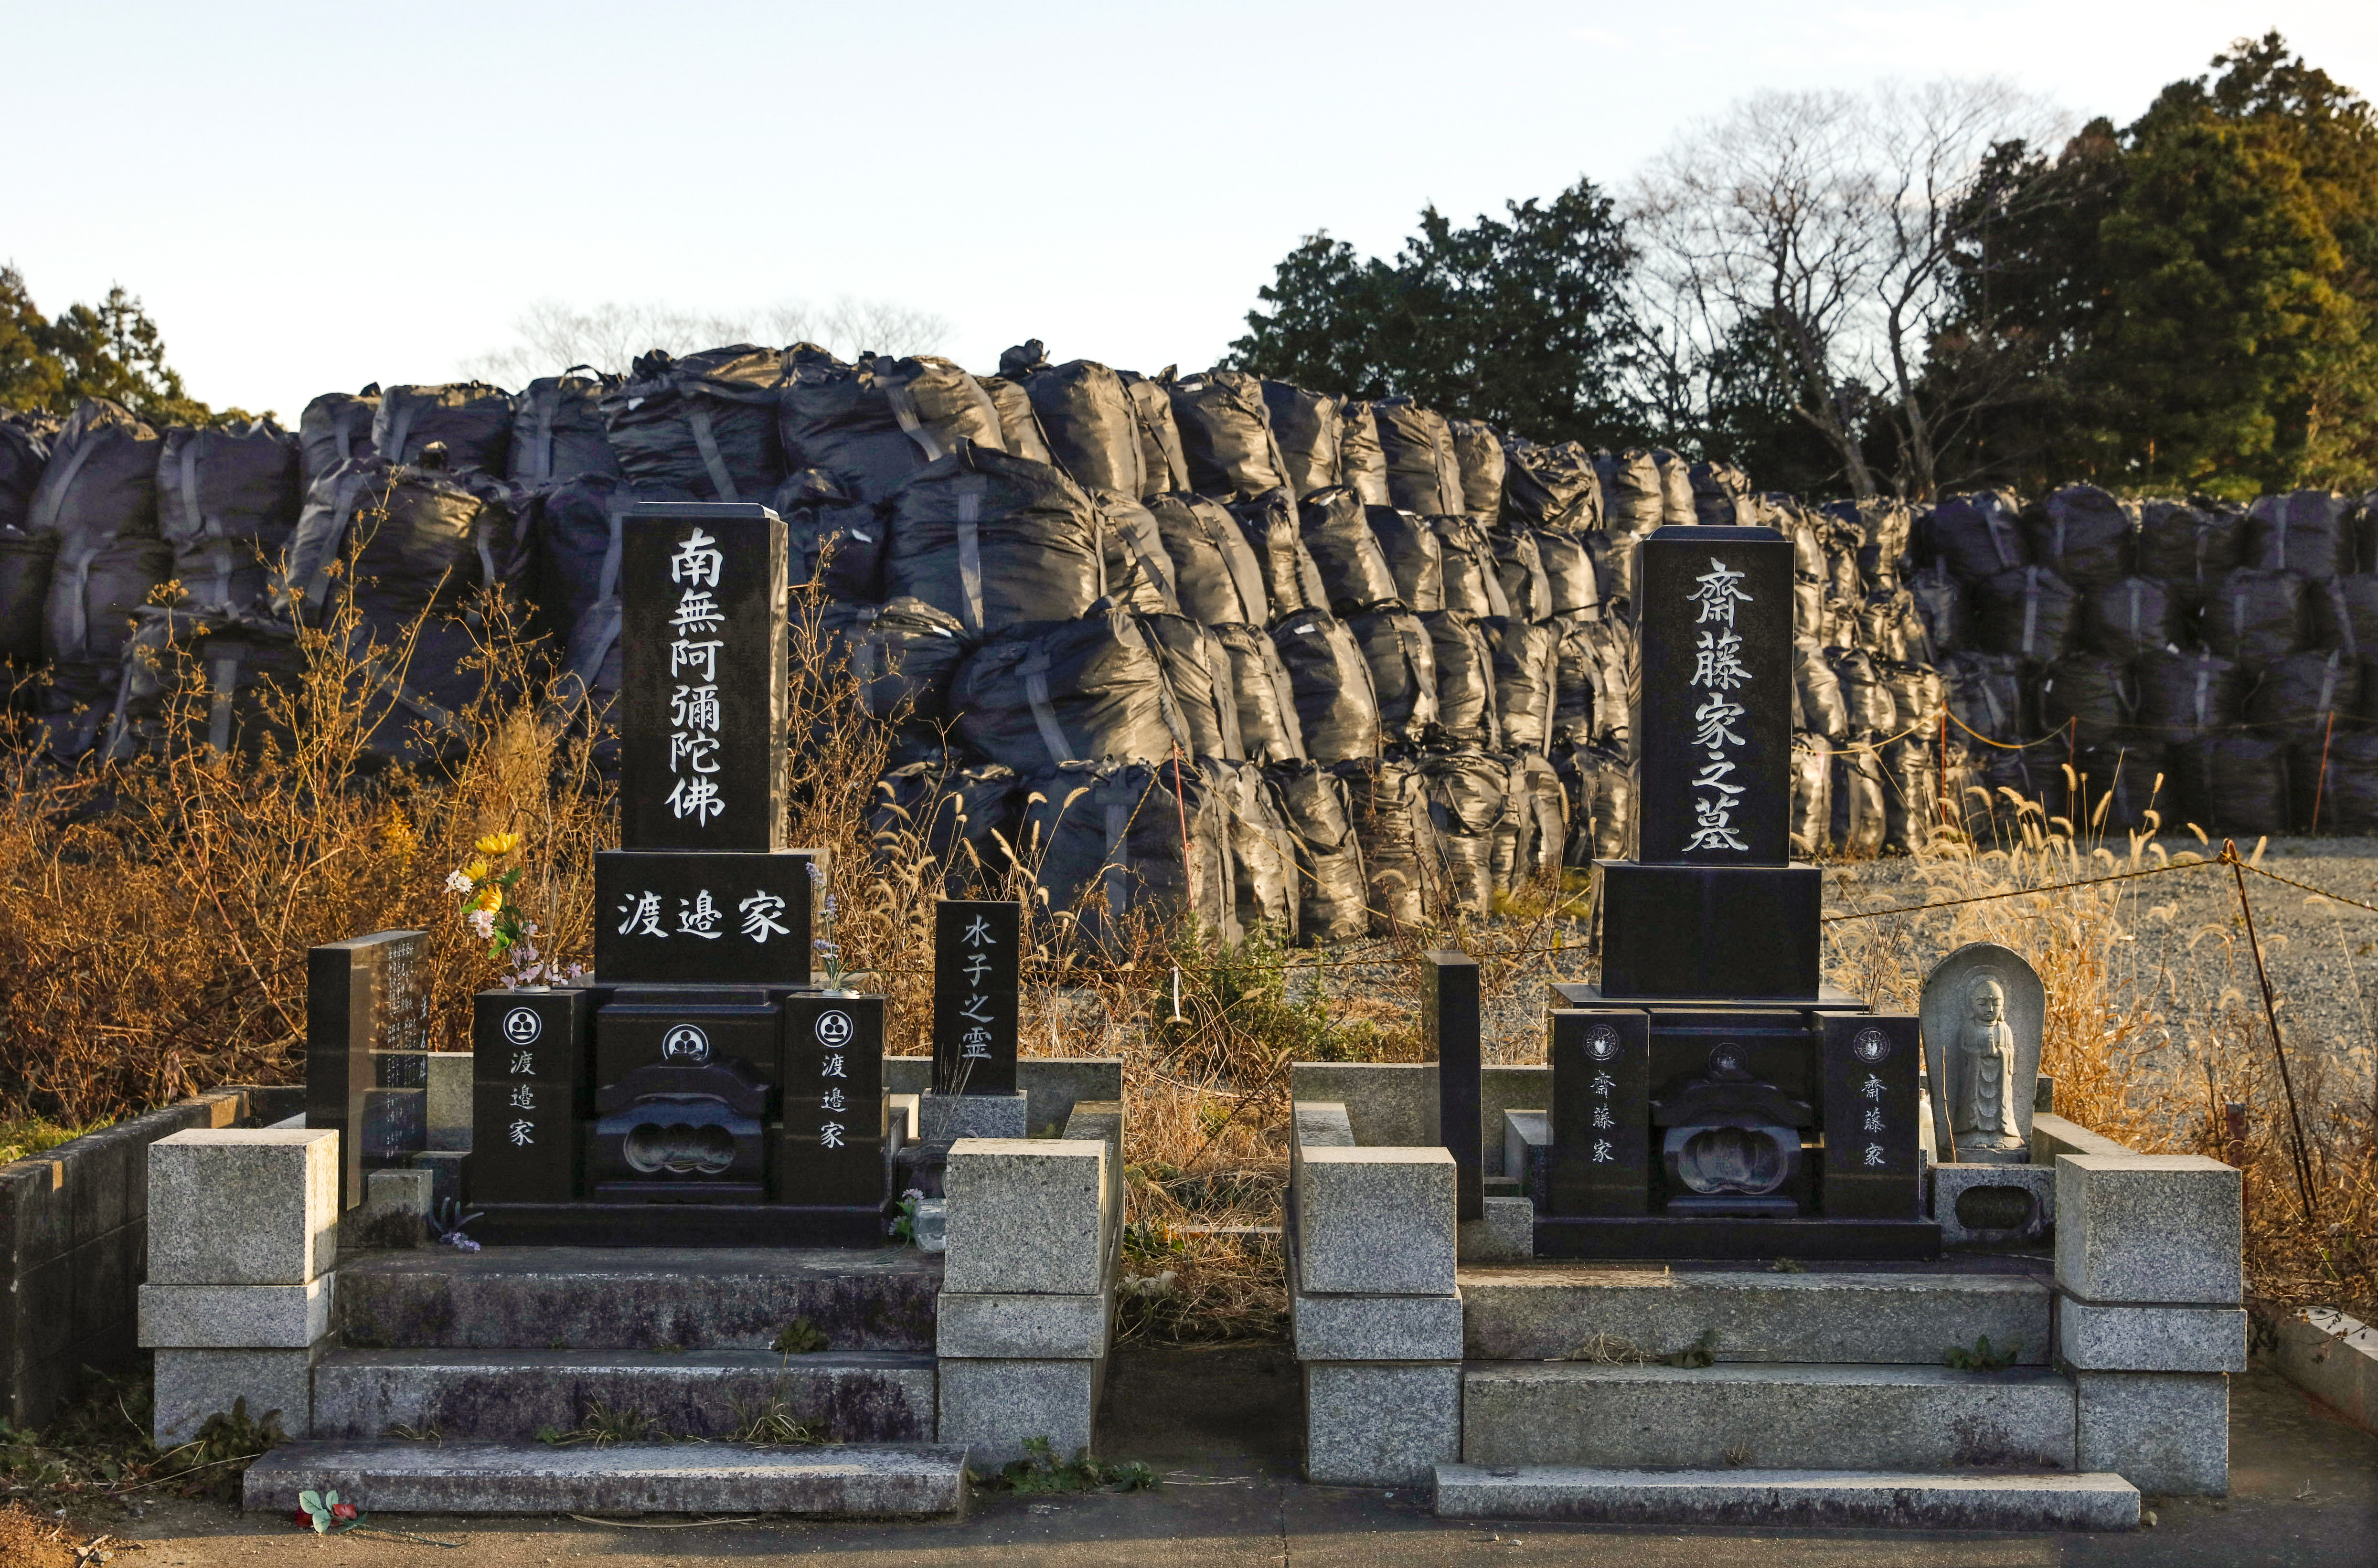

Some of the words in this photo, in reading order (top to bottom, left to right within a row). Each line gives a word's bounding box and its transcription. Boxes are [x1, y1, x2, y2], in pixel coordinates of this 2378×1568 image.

[664, 527, 725, 827] 南無阿彌陀佛
[960, 914, 997, 1059] 水子之霊
